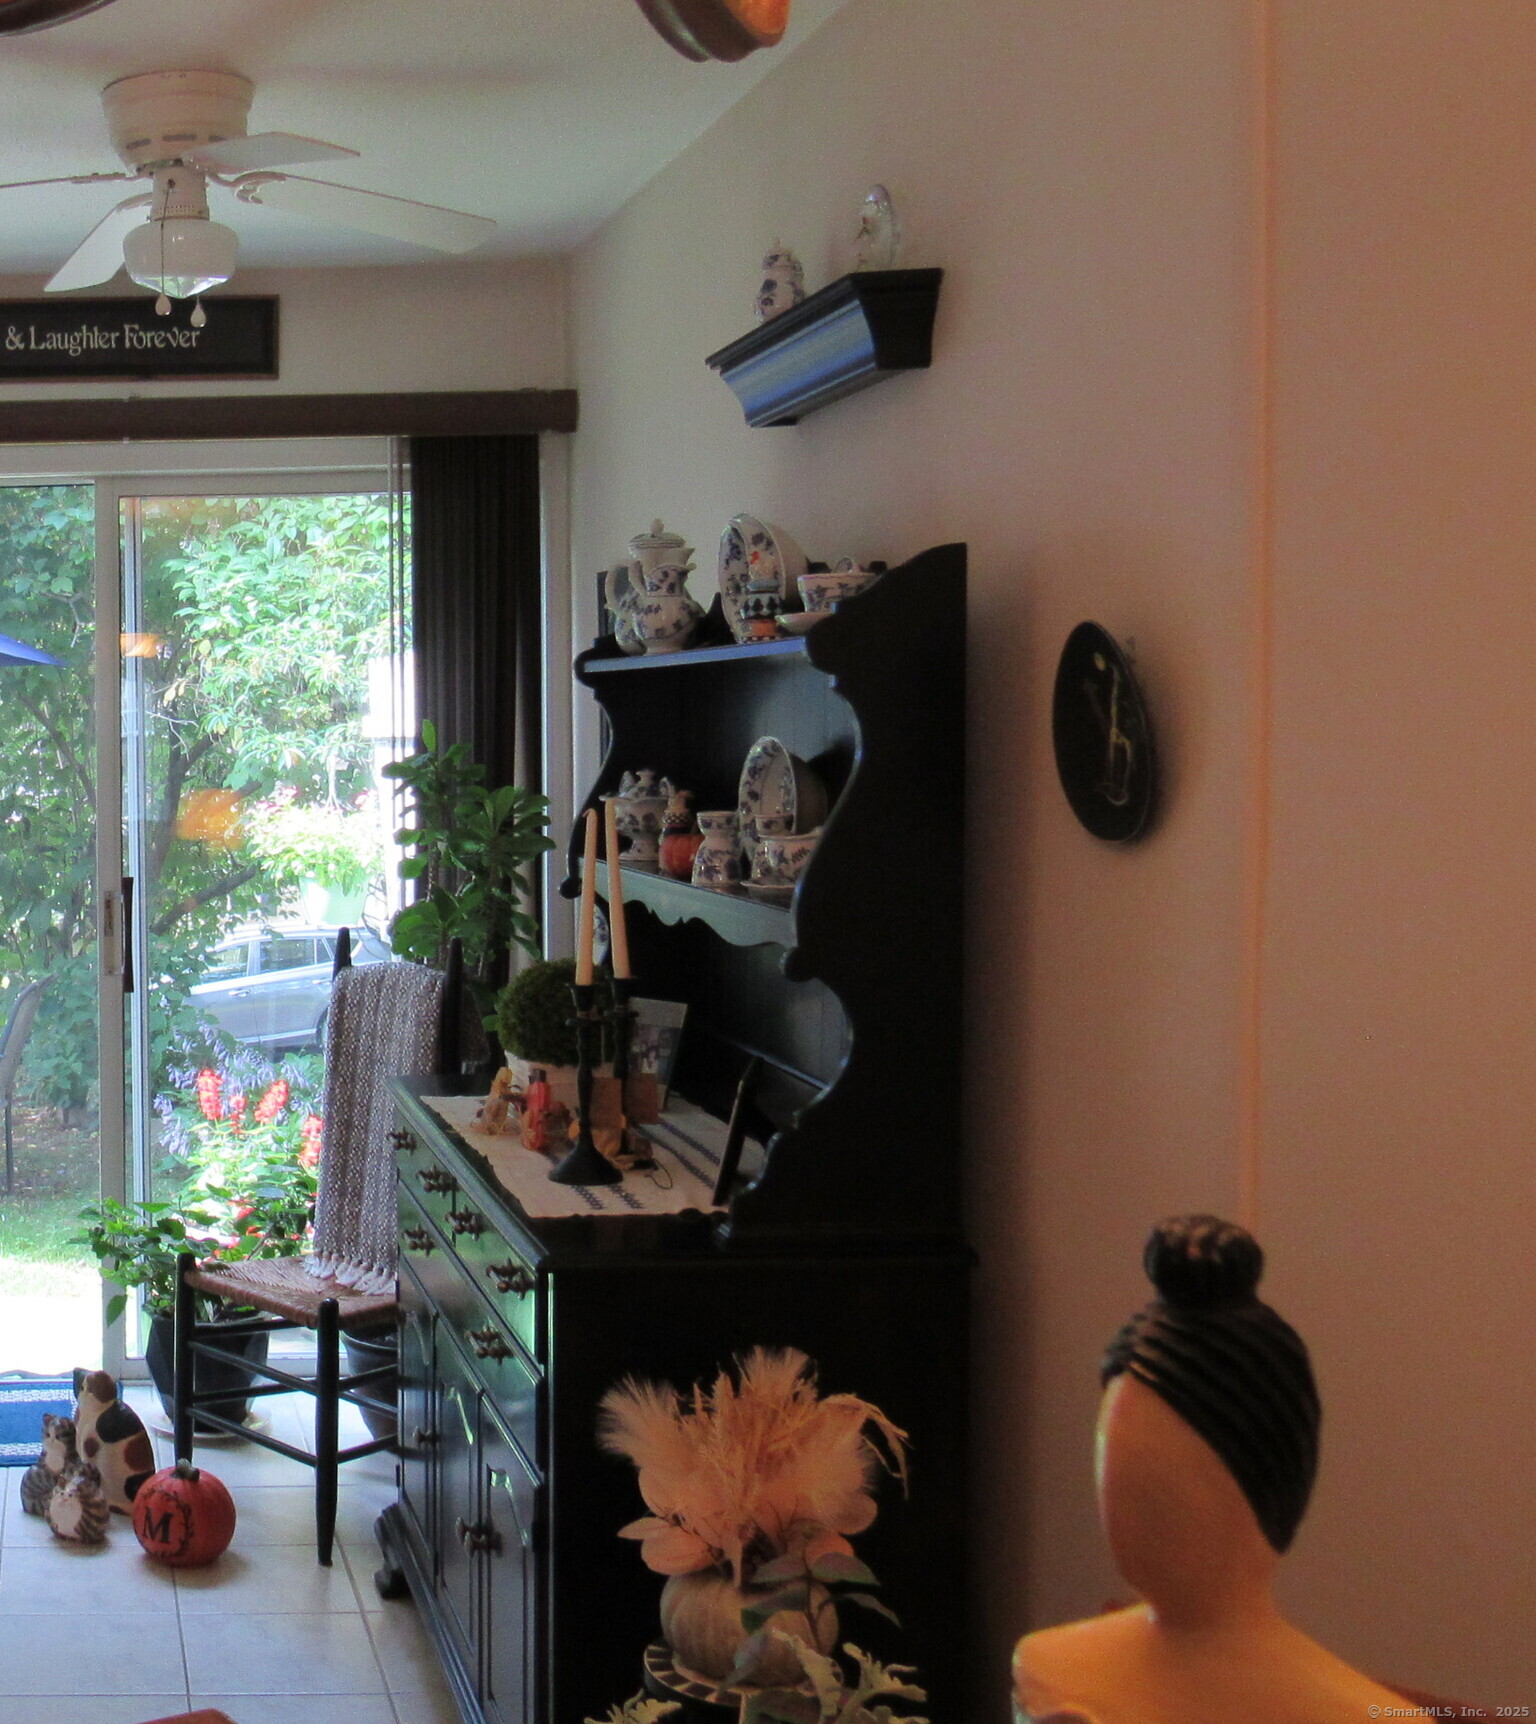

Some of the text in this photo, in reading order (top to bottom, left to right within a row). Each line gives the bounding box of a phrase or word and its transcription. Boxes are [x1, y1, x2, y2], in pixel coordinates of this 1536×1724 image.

[5, 326, 25, 350] &
[29, 324, 120, 356] Laughter
[123, 324, 201, 349] Forever
[143, 1506, 175, 1544] M
